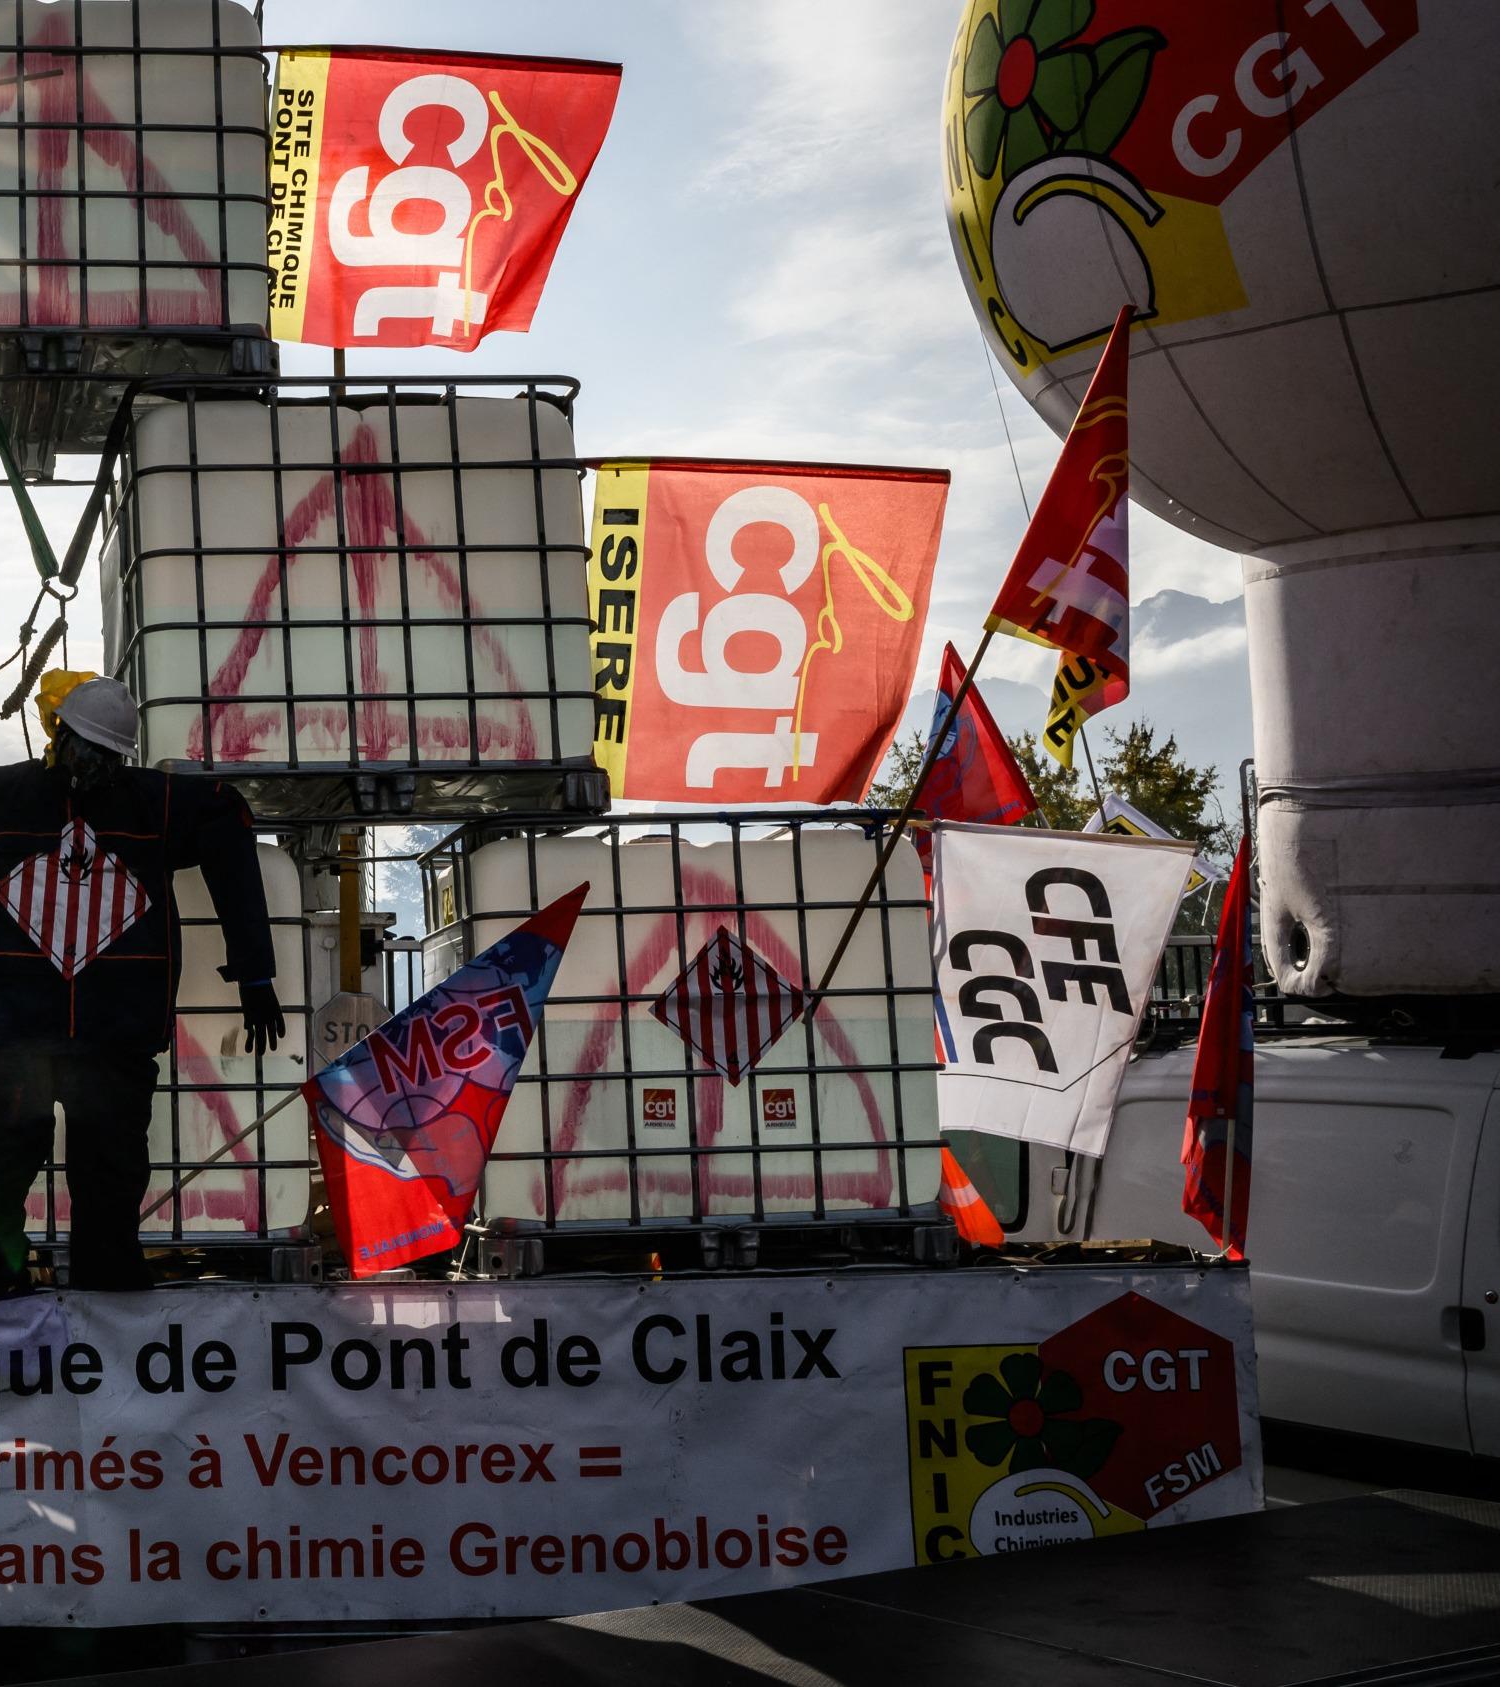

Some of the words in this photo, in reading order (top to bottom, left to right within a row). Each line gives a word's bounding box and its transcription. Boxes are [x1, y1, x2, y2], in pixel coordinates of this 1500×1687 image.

[294, 89, 315, 157] SITE
[1172, 0, 1386, 177] CGT
[273, 89, 295, 171] PONT
[271, 183, 288, 220] DE
[279, 168, 308, 309] CHIMIQUE
[328, 74, 489, 338] cgt
[594, 508, 639, 743] ISERE
[656, 485, 820, 788] cgt
[1025, 866, 1134, 1016] CFE
[324, 1021, 371, 1043] STO
[949, 929, 1059, 1074] CGC
[644, 1098, 675, 1118] cgt
[765, 1098, 795, 1118] cgt
[135, 1324, 238, 1393] de
[270, 1321, 471, 1391] Pont
[500, 1318, 602, 1389] de
[631, 1312, 843, 1384] Claix
[1103, 1348, 1209, 1393] CGT
[188, 1435, 223, 1488] à
[244, 1432, 556, 1488] Vencorex
[579, 1446, 623, 1478] =
[917, 1360, 967, 1565] FNIC
[1143, 1442, 1223, 1509] FSM
[130, 1528, 181, 1583] la
[205, 1525, 426, 1581] chimie
[449, 1513, 849, 1577] Grenobloise
[994, 1508, 1079, 1527] Industries
